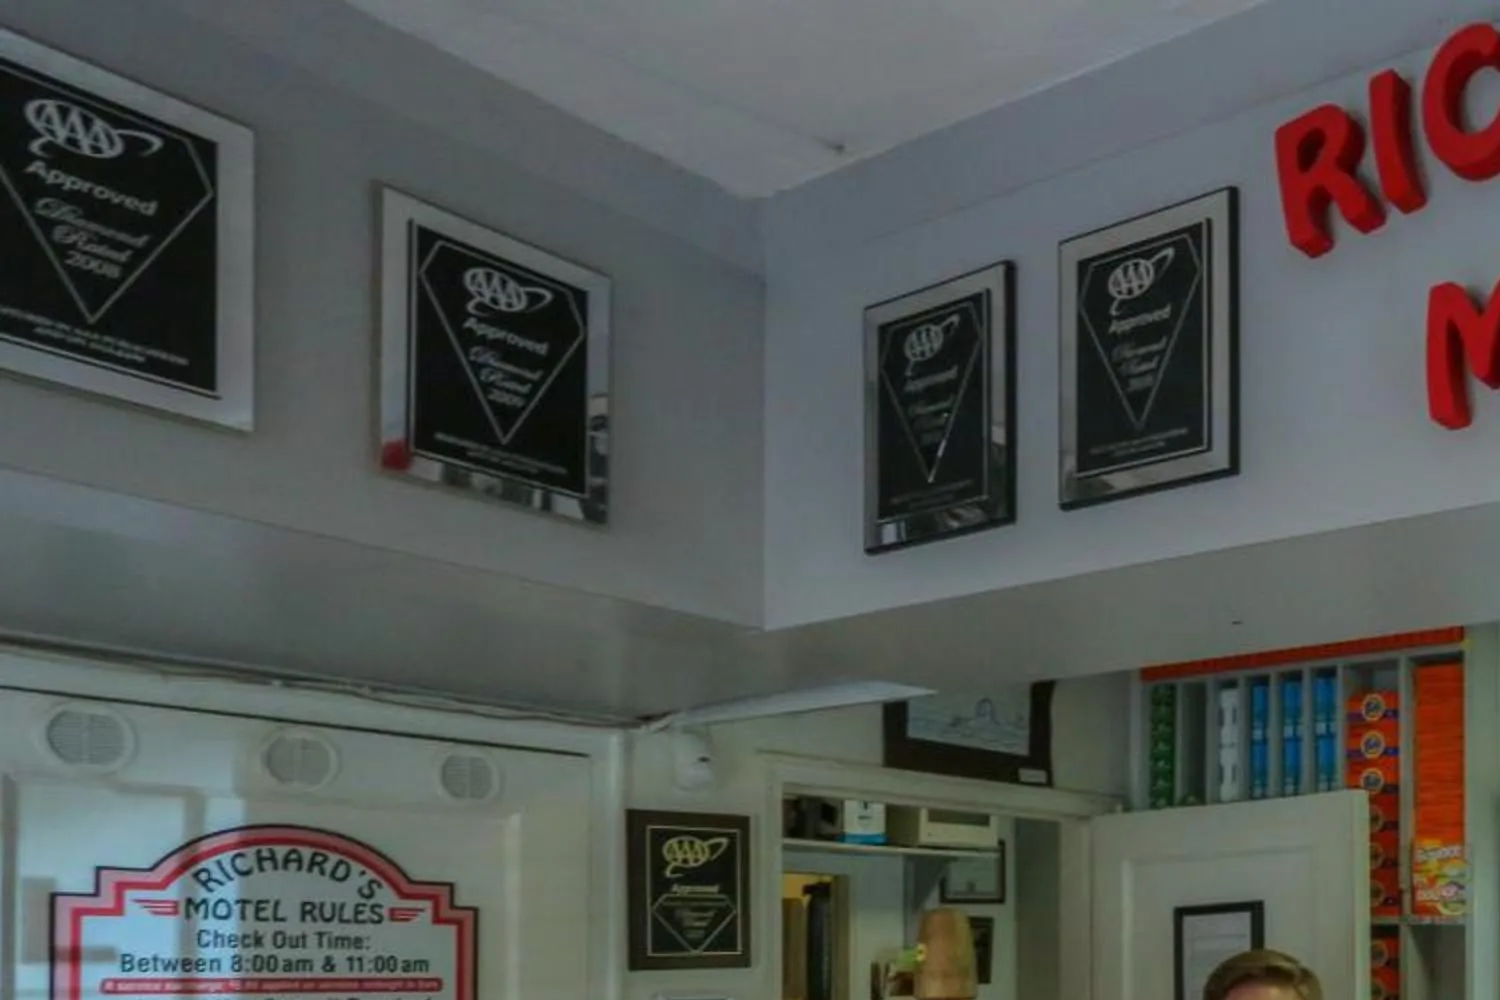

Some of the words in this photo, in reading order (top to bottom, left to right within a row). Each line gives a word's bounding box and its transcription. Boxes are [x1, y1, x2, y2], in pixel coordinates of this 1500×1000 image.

[24, 99, 124, 158] AAA
[25, 159, 159, 216] Approved
[463, 267, 529, 312] AAA
[463, 317, 550, 356] Approved
[662, 836, 710, 868] AAA
[192, 848, 383, 900] RICHARD'S
[184, 897, 288, 924] MOTEL
[300, 902, 385, 925] RULES
[196, 928, 265, 951] Check
[272, 930, 308, 950] Out
[316, 930, 371, 951] Time:
[120, 954, 222, 974] Between
[321, 954, 337, 974] &
